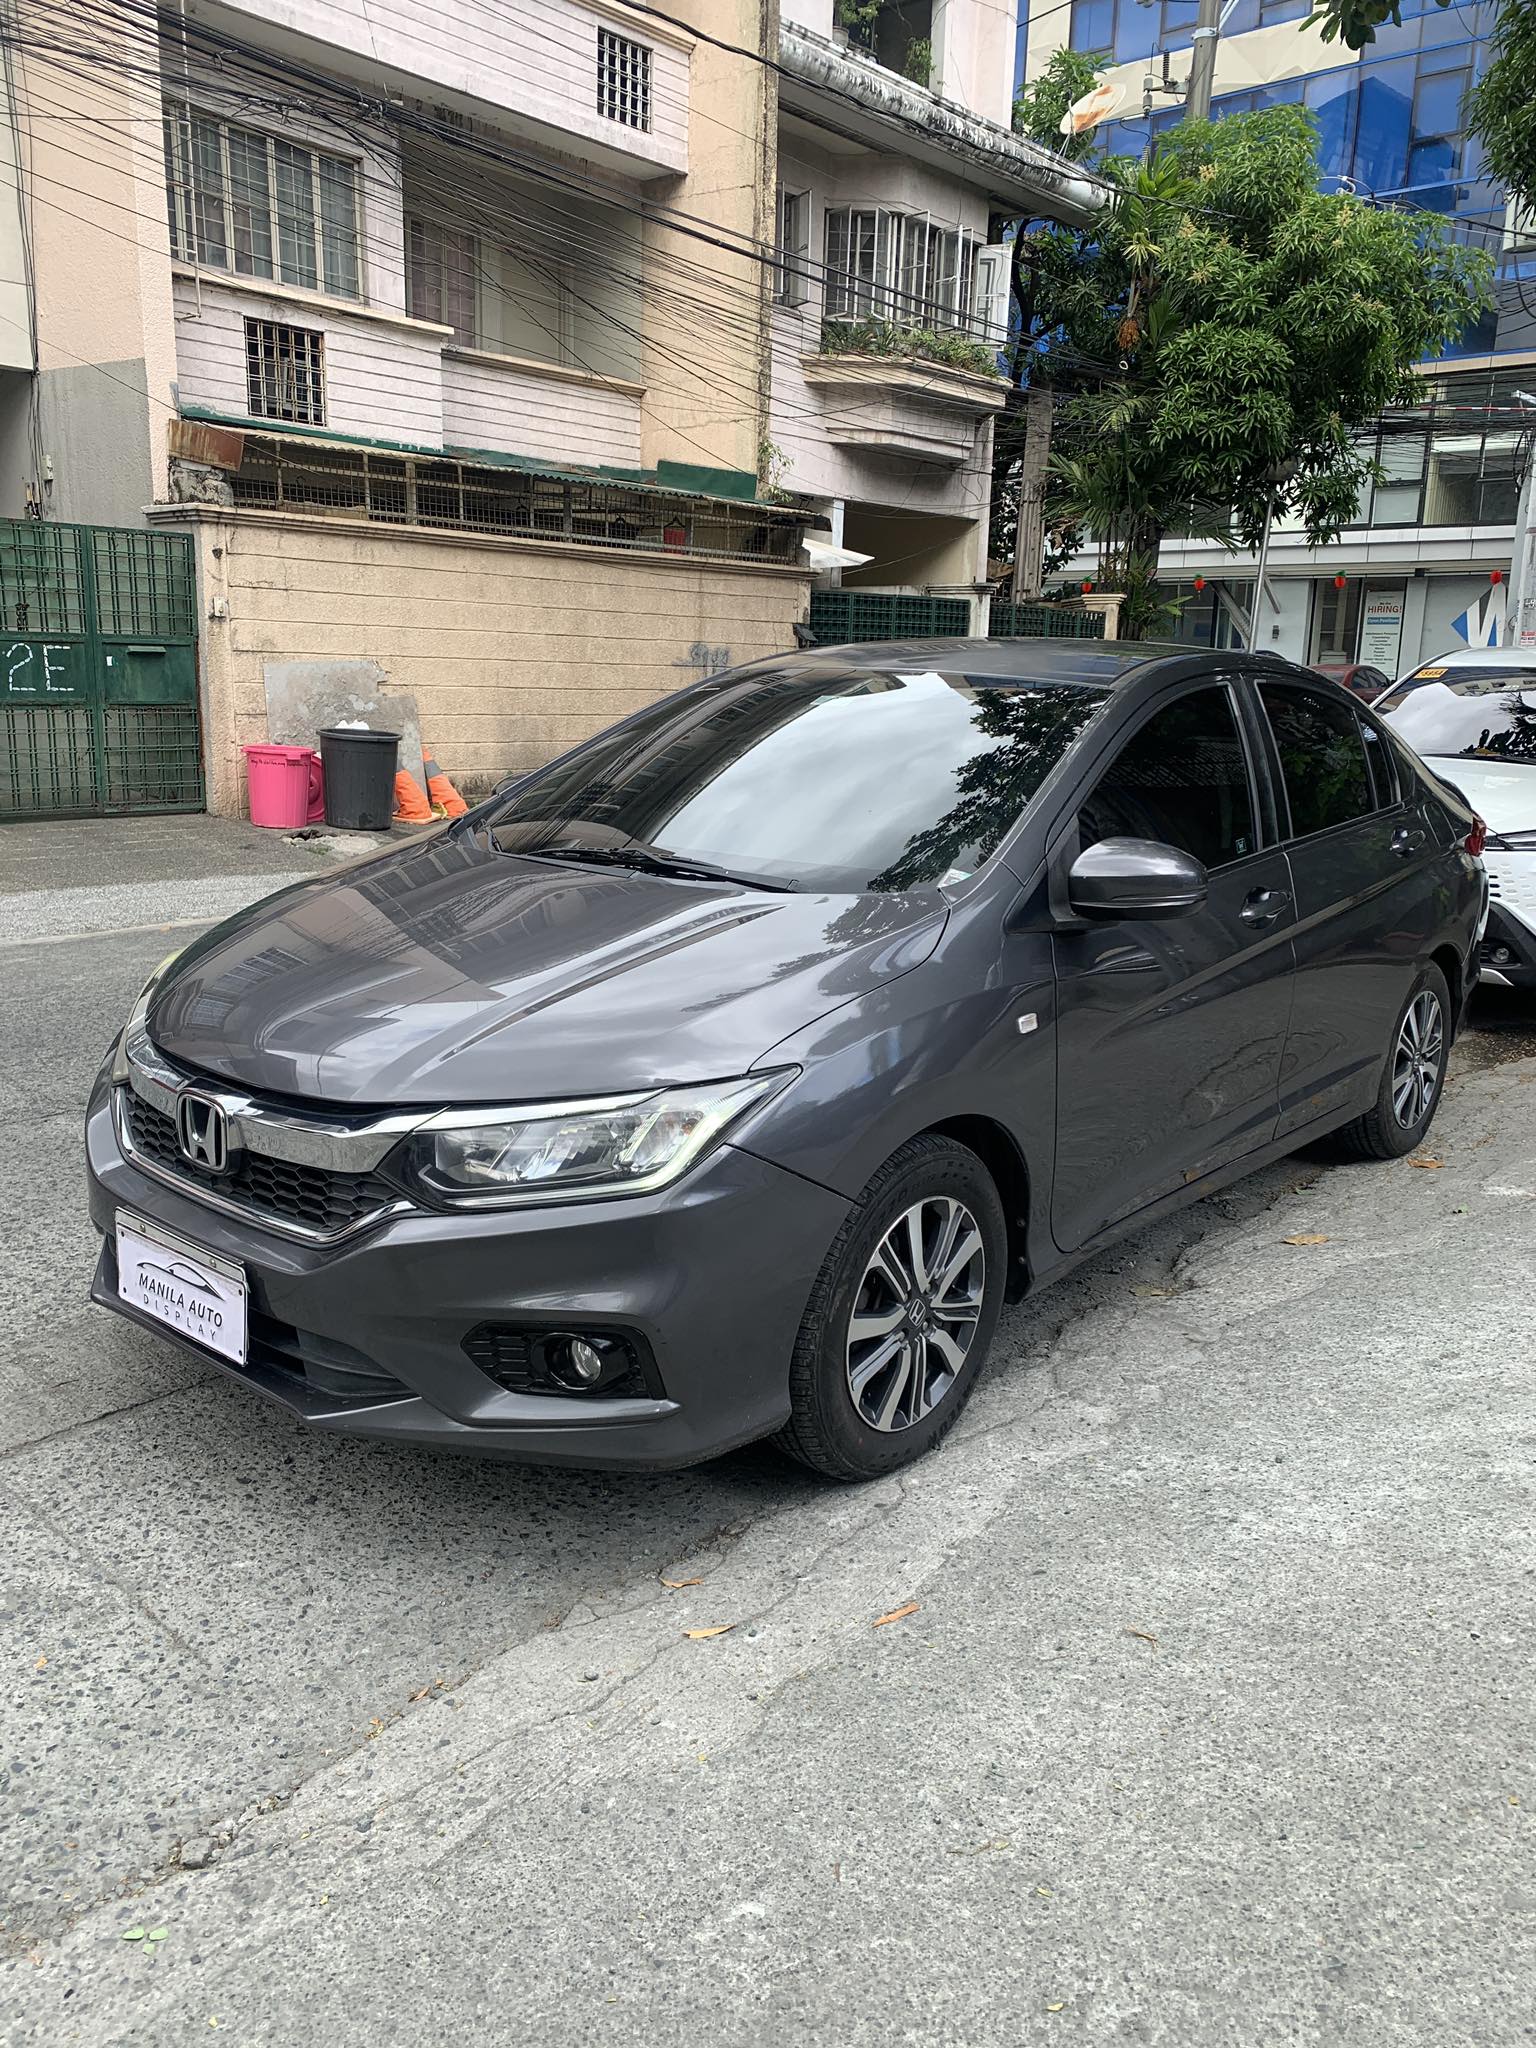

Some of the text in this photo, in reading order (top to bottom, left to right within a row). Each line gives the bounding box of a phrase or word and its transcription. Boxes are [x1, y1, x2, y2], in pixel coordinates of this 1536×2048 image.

[1367, 605, 1403, 614] HIRING!
[6, 643, 75, 692] 2E
[138, 1273, 223, 1328] MANILA AUTO
[142, 1294, 217, 1342] DISPLAY
